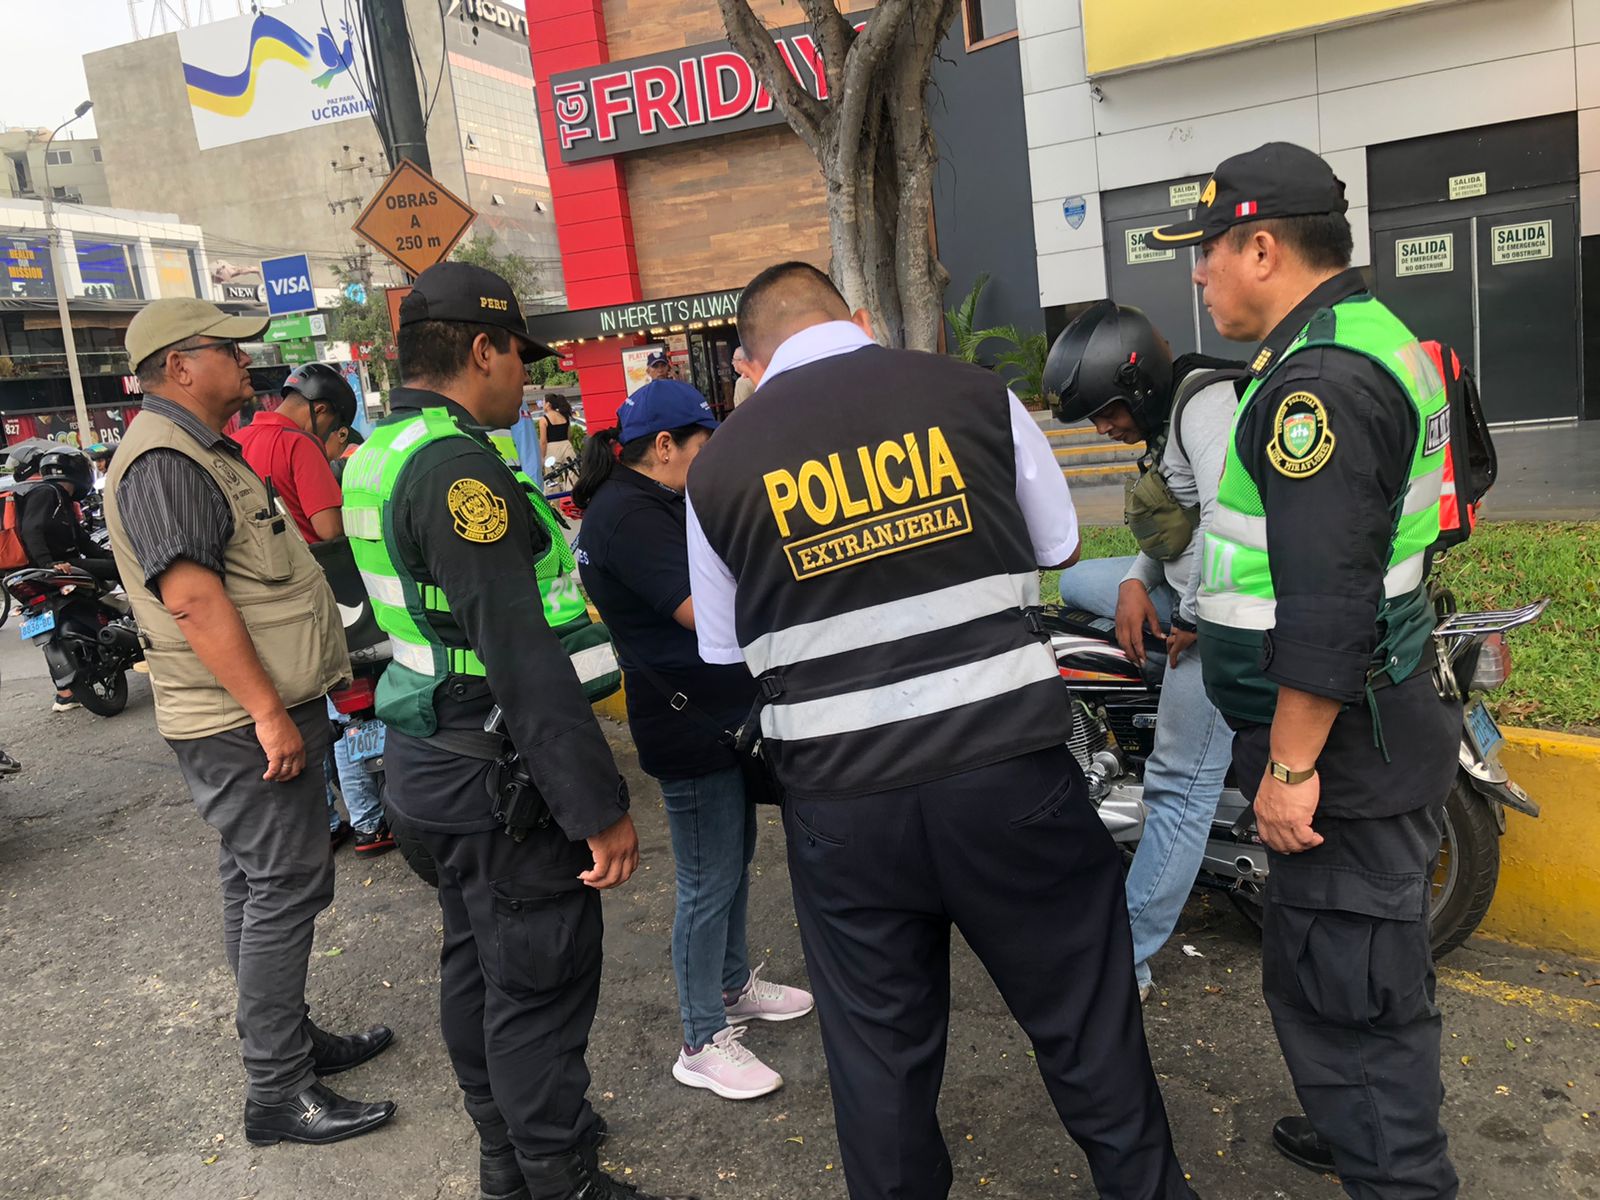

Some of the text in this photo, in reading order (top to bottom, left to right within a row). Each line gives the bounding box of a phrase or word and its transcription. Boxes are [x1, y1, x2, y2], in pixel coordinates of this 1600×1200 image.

[311, 98, 374, 121] UCRANIA
[554, 81, 592, 149] TGI
[1454, 176, 1481, 186] SALIDA
[385, 191, 438, 210] OBRAS
[410, 214, 421, 229] A
[1498, 226, 1546, 244] SALIDA
[396, 235, 441, 252] 250 m
[1402, 240, 1447, 257] SALIDA
[1506, 240, 1546, 251] EMERGENCIA
[1410, 254, 1448, 263] EMERGENCIA
[1511, 249, 1542, 258] OBSTRUIR
[8, 266, 44, 279] MISSION
[1414, 262, 1444, 271] OBSTRUIR
[229, 287, 255, 298] NEW
[268, 275, 310, 297] VISA
[480, 296, 508, 311] PERU
[600, 292, 743, 332] IN HERE IT'S ALWAY
[5, 424, 20, 436] 827
[1284, 442, 1331, 472] MIRAFLORES
[797, 506, 962, 571] EXTRANJERIA
